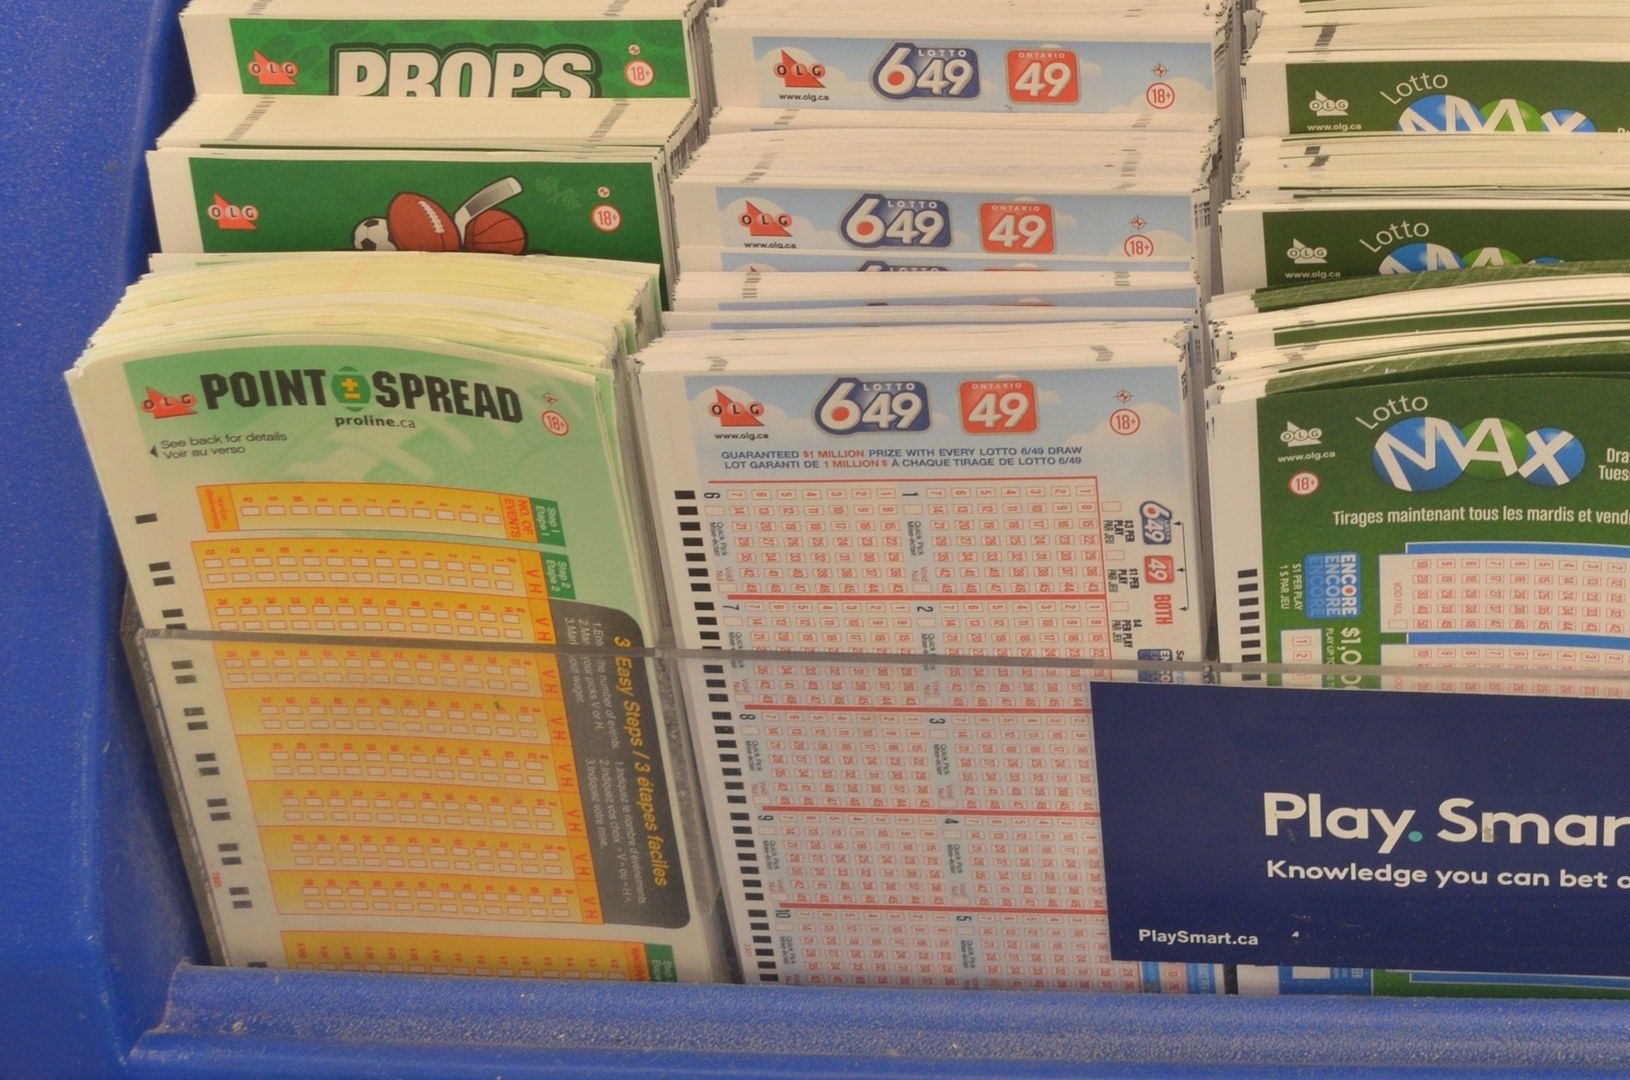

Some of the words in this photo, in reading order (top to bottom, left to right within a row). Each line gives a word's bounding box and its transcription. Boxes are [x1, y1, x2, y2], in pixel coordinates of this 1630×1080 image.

[336, 50, 595, 98] PROPS
[200, 369, 326, 411] POINT
[372, 372, 523, 424] SPREAD
[863, 382, 915, 391] LOTTO
[820, 383, 922, 431] 649
[968, 391, 1026, 428] 49
[1356, 394, 1429, 430] Lotto
[334, 415, 416, 429] proline.ca
[160, 439, 184, 450] See
[188, 436, 220, 448] back
[223, 434, 243, 446] for
[246, 432, 288, 444] details
[714, 432, 769, 440] www.olg.ca
[163, 449, 190, 460] Voir
[193, 448, 208, 458] au
[211, 445, 245, 456] verso
[721, 450, 799, 459] GUARANTEED
[803, 449, 813, 458] $1
[817, 449, 864, 458] MILLION
[868, 449, 902, 458] PRIZE
[906, 448, 935, 457] WITH
[939, 448, 976, 457] EVERY
[980, 447, 1017, 456] LOTTO
[1021, 446, 1044, 456] 6/49
[1048, 446, 1082, 455] DRAW
[1375, 416, 1574, 492] MAX
[1333, 510, 1384, 528] Tirages
[1387, 507, 1464, 523] maintenant
[1468, 506, 1499, 520] tous
[1503, 505, 1523, 520] les
[1527, 506, 1574, 522] mardis
[1578, 509, 1592, 522] et
[1266, 860, 1427, 887] Knowledge
[1435, 868, 1488, 888] you
[1497, 868, 1549, 887] can
[1560, 869, 1607, 888] bet
[1138, 928, 1259, 947] PlaySmart.ca
